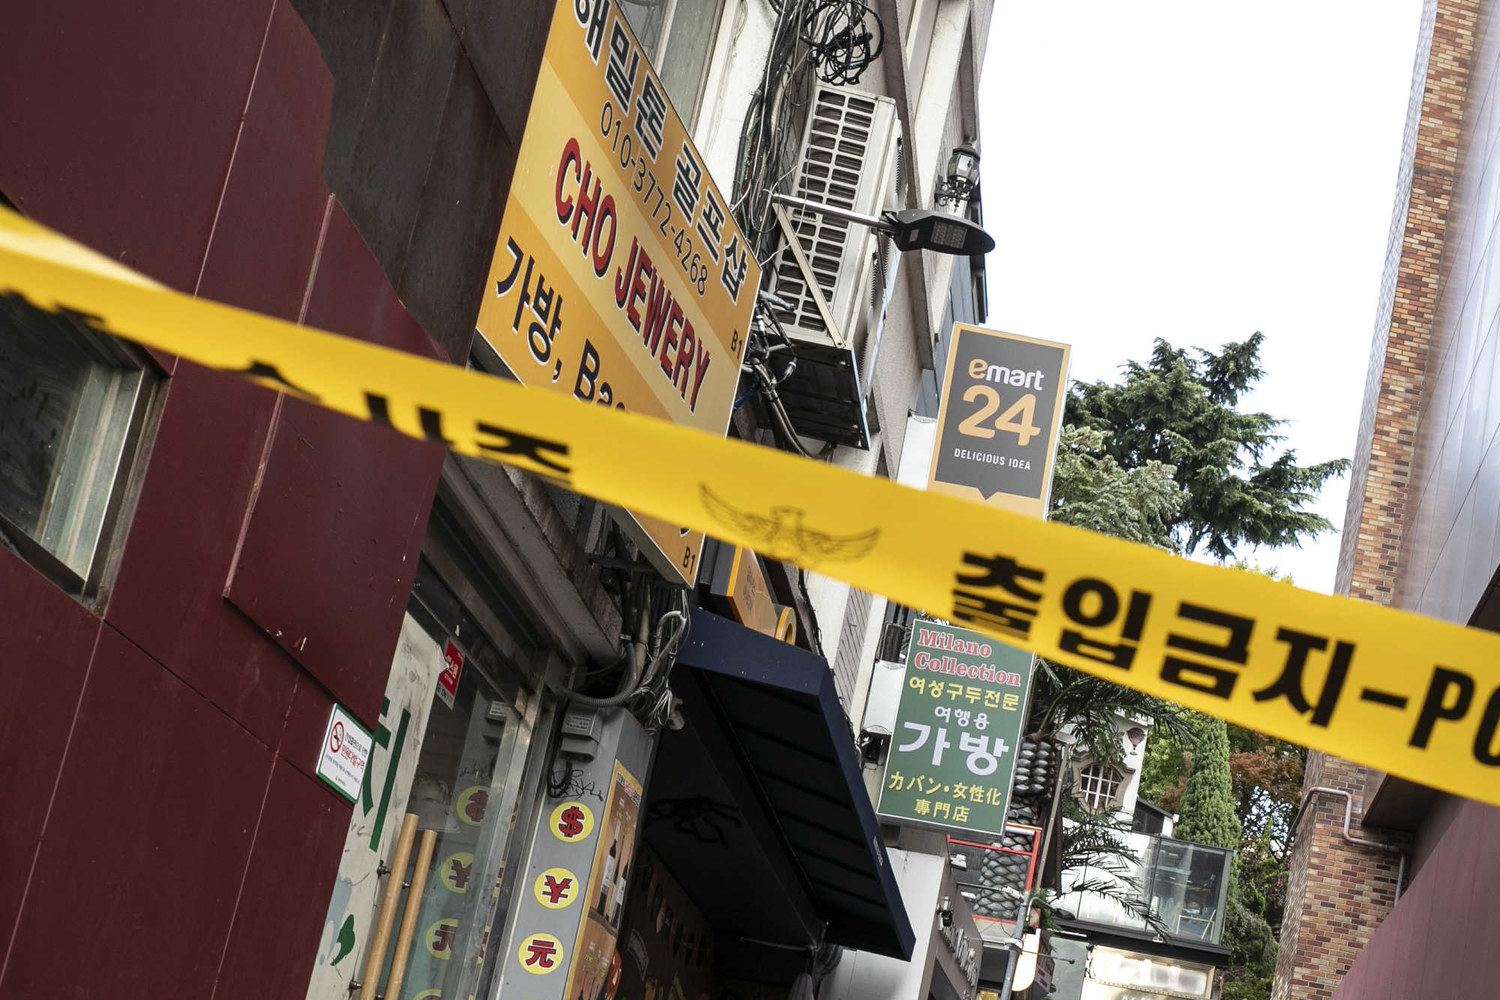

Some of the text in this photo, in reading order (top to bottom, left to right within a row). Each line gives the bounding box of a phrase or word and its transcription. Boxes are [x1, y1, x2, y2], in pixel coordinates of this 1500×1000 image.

[600, 101, 708, 296] 010-3772-4268
[672, 140, 747, 306] 골프샵
[555, 137, 711, 415] CHO JEWERY
[731, 328, 743, 359] B1
[968, 358, 1044, 391] emart
[958, 384, 1041, 447] 24
[953, 447, 1031, 471] DELICIOUS IDEA
[682, 545, 695, 575] B1
[916, 628, 993, 659] Milano
[914, 651, 1021, 687] Collection
[909, 676, 1019, 711] 여성구두전문
[934, 705, 990, 730] 여행용
[898, 721, 1010, 776] 가방
[525, 939, 557, 968] 元
